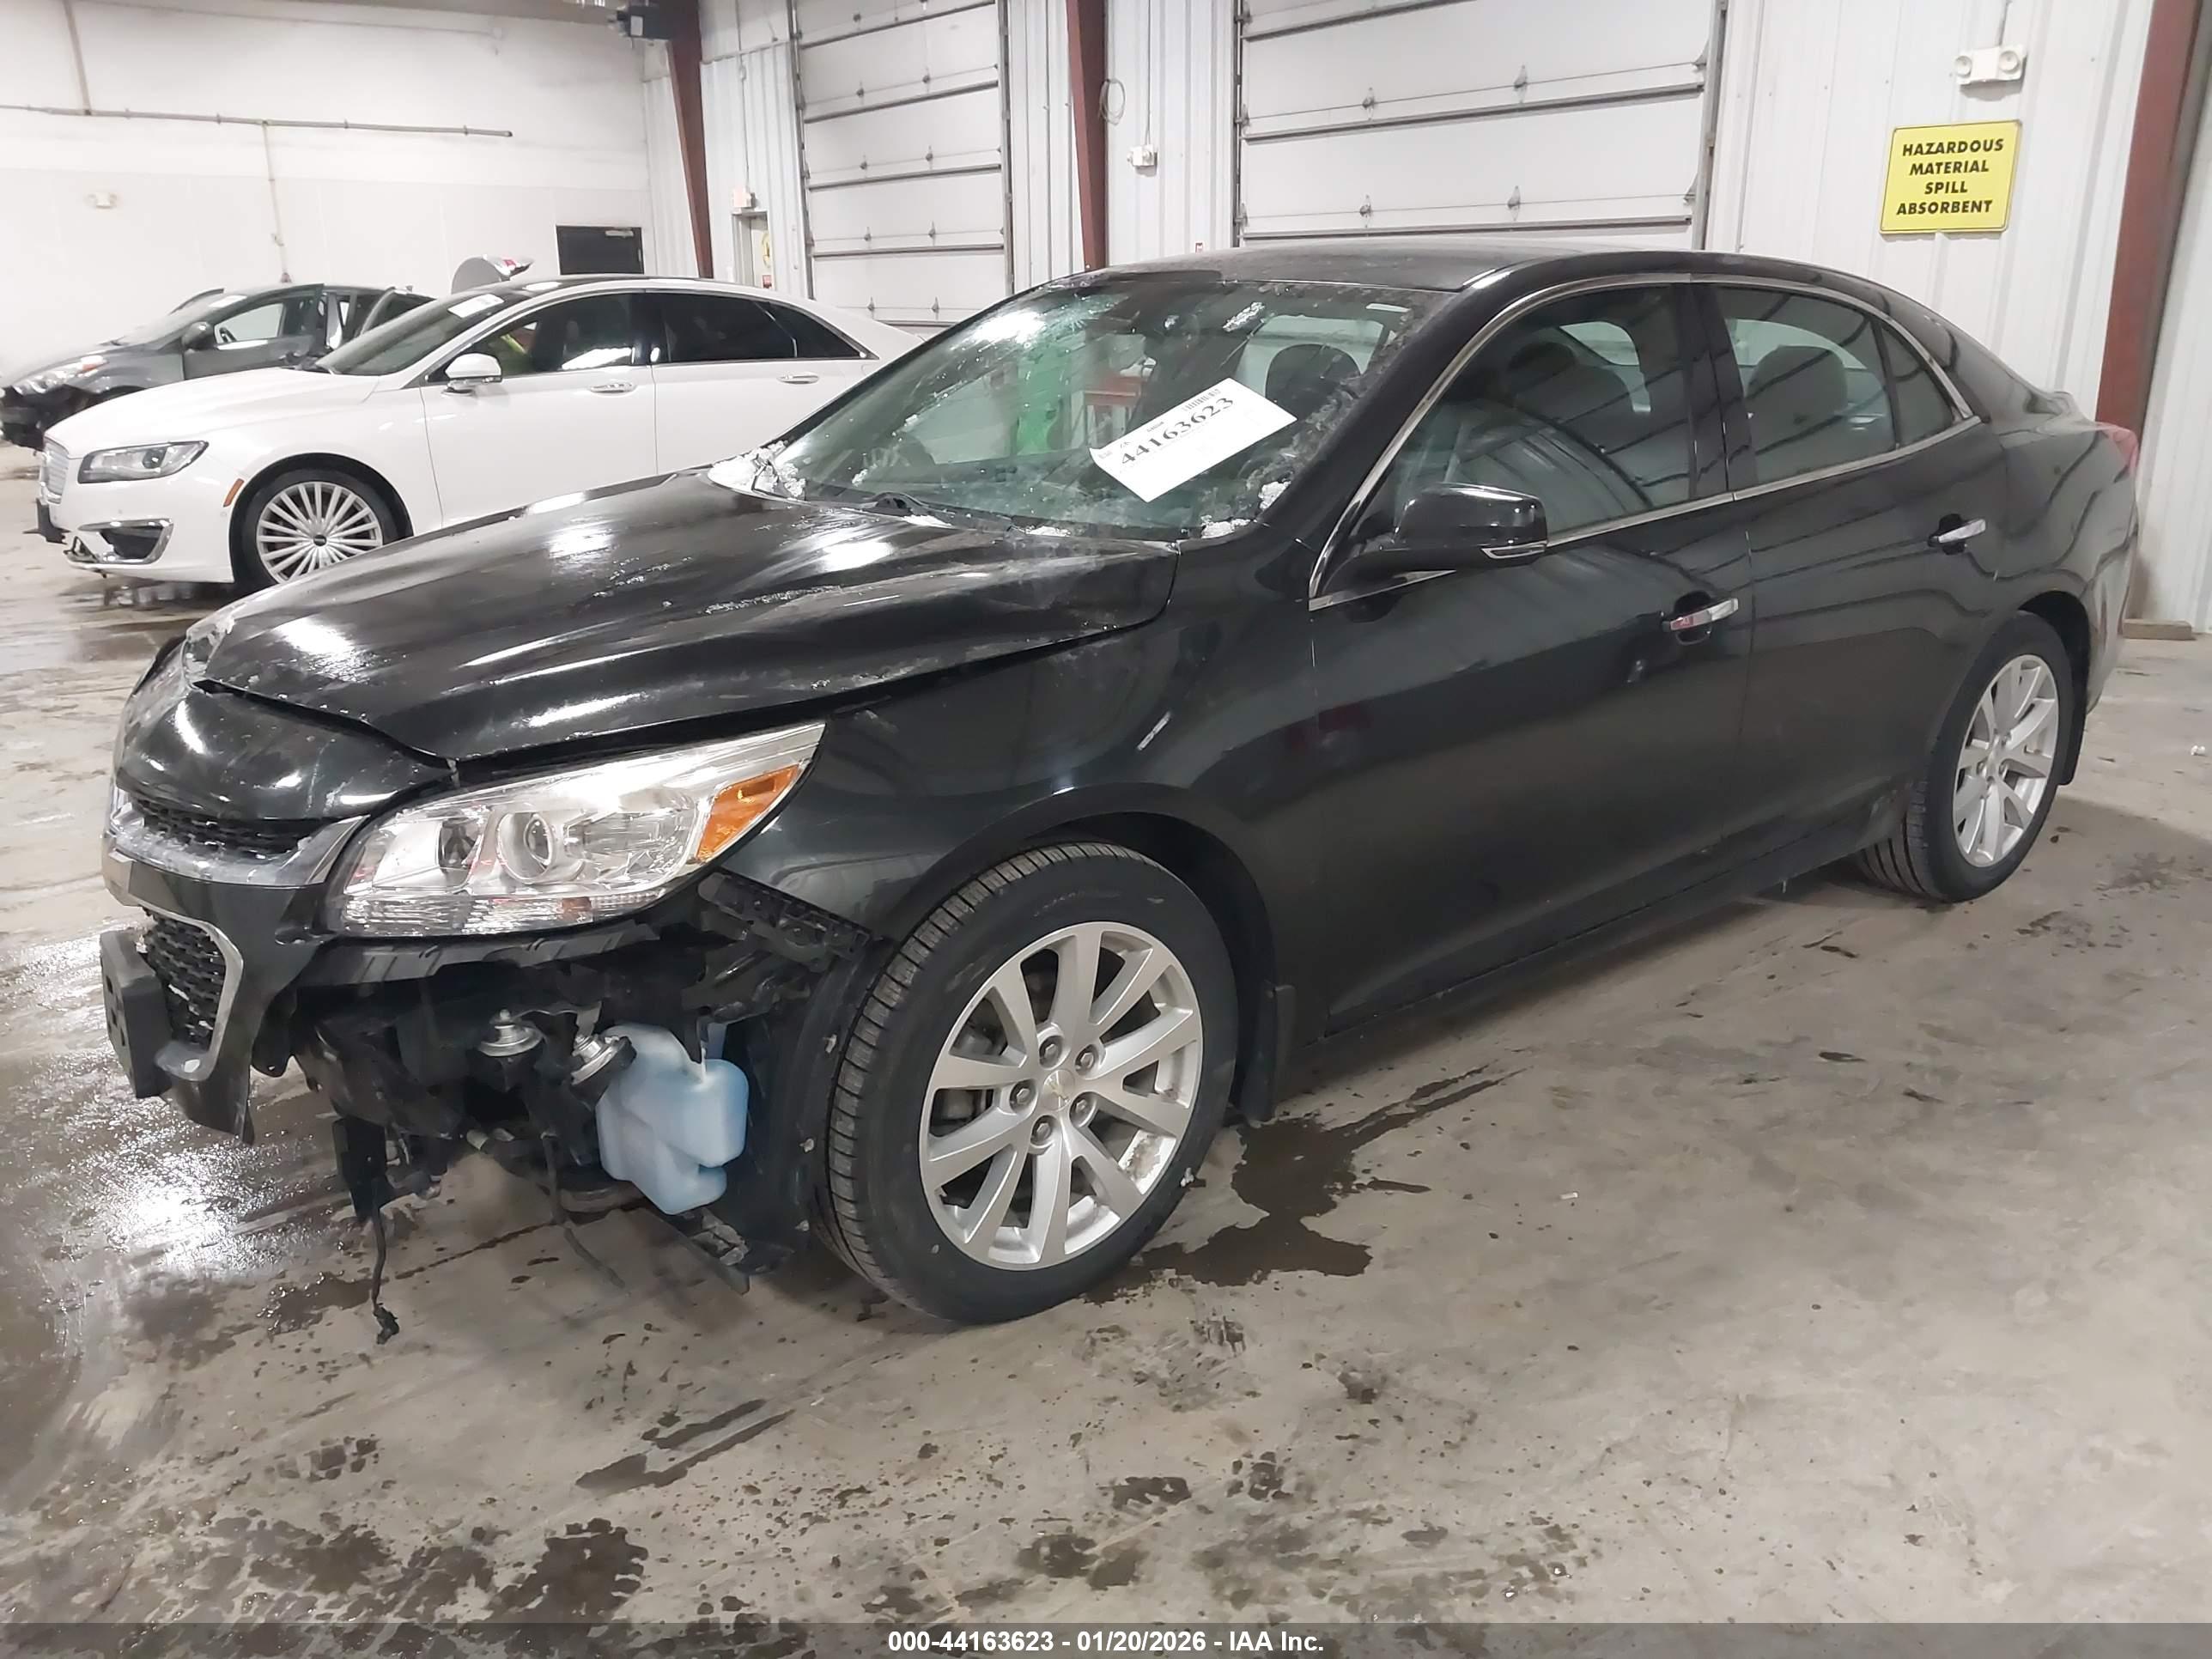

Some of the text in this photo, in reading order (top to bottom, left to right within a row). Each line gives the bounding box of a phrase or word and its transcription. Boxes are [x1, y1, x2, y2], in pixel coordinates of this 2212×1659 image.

[1902, 138, 2004, 156] HAZARDOUS
[1909, 160, 1990, 176] MATERIAL
[1924, 181, 1968, 195] SPILL
[1896, 200, 1993, 216] ABSORBENT
[1121, 397, 1235, 465] 44163623
